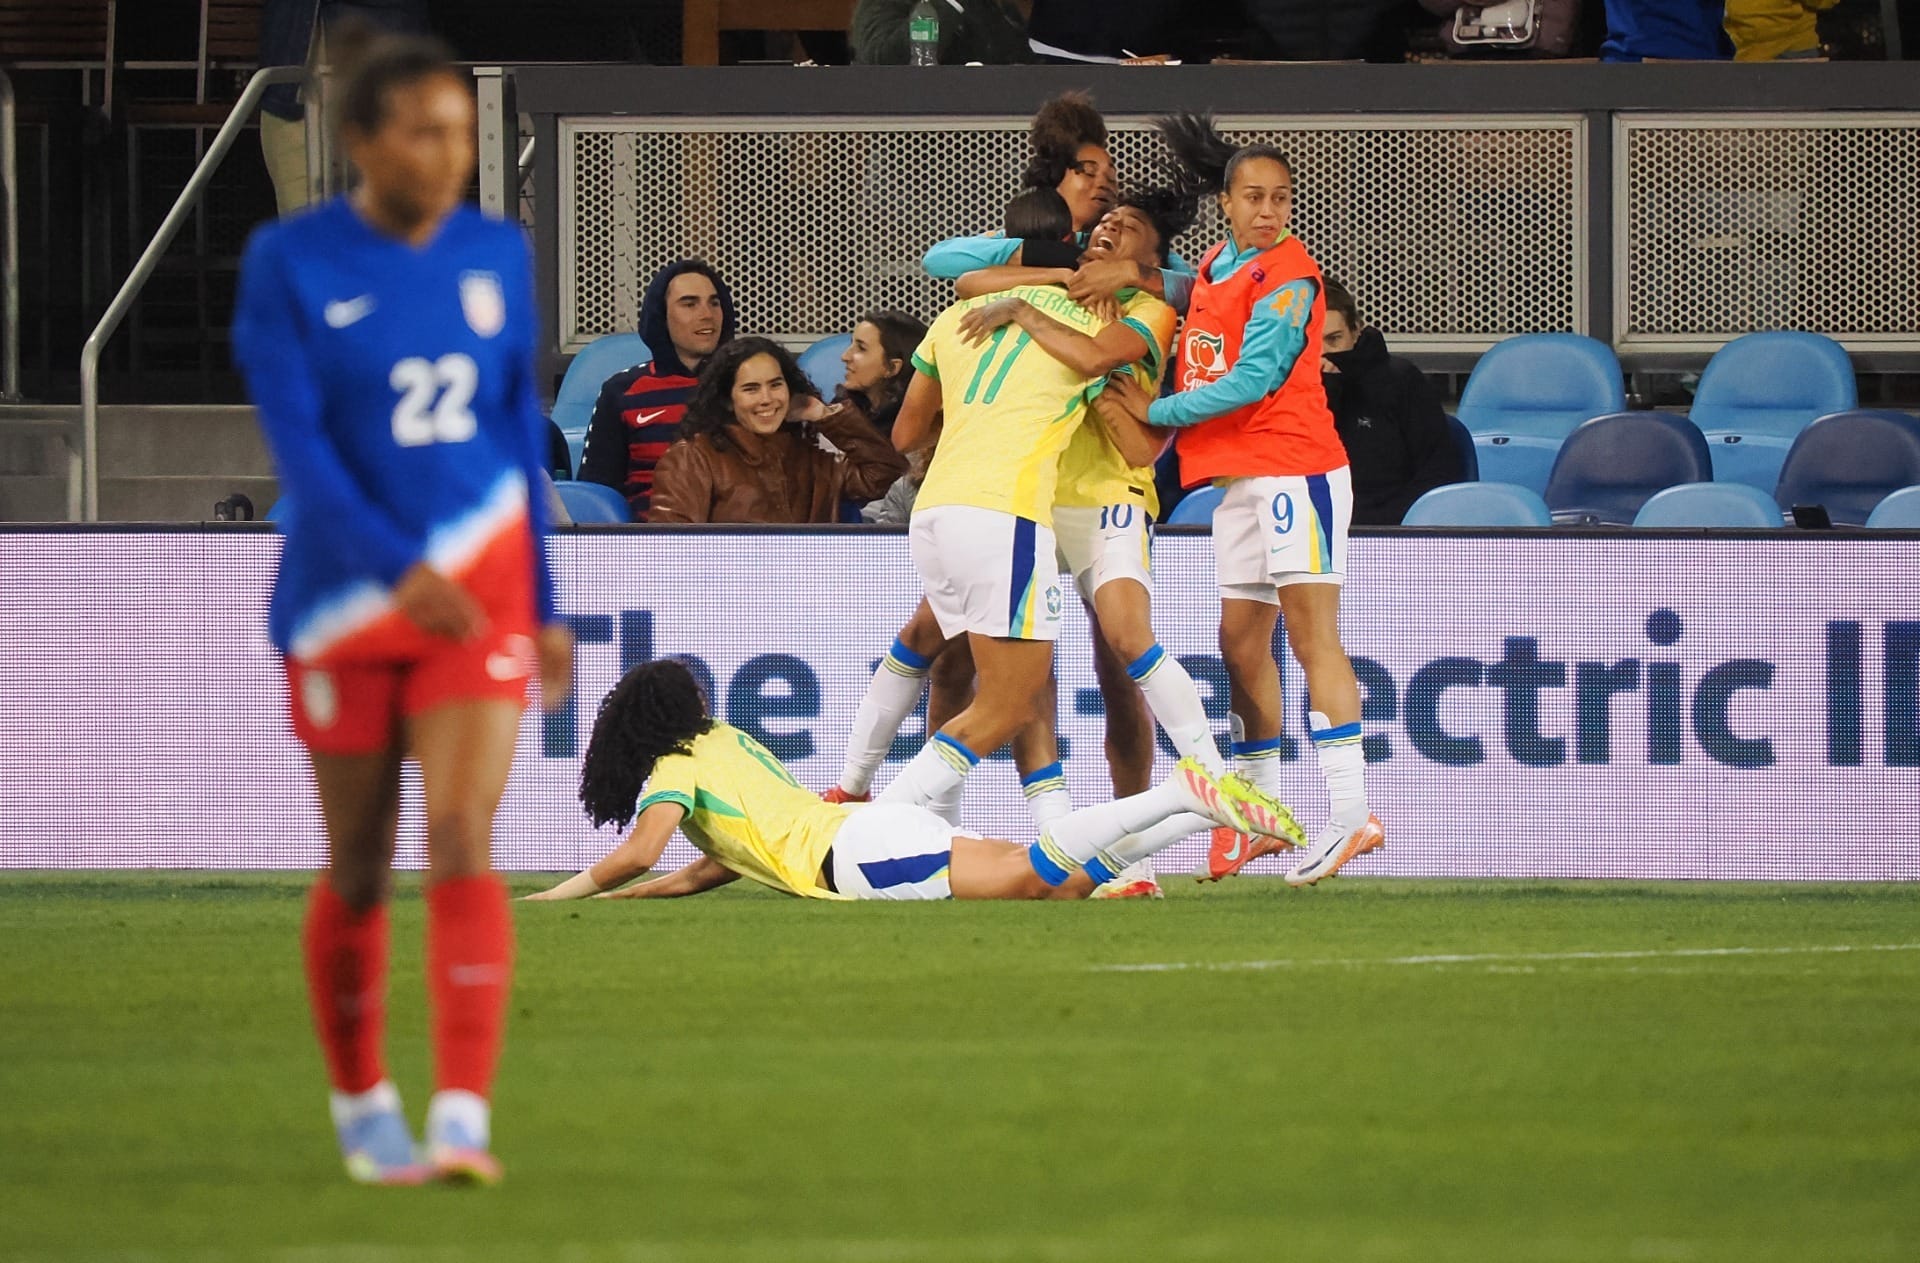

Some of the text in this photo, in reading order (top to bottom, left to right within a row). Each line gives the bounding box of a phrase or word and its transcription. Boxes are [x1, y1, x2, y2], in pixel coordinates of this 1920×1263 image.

[963, 322, 1031, 404] 11
[389, 352, 479, 447] 22
[1099, 503, 1132, 529] 10
[1272, 492, 1294, 534] 9
